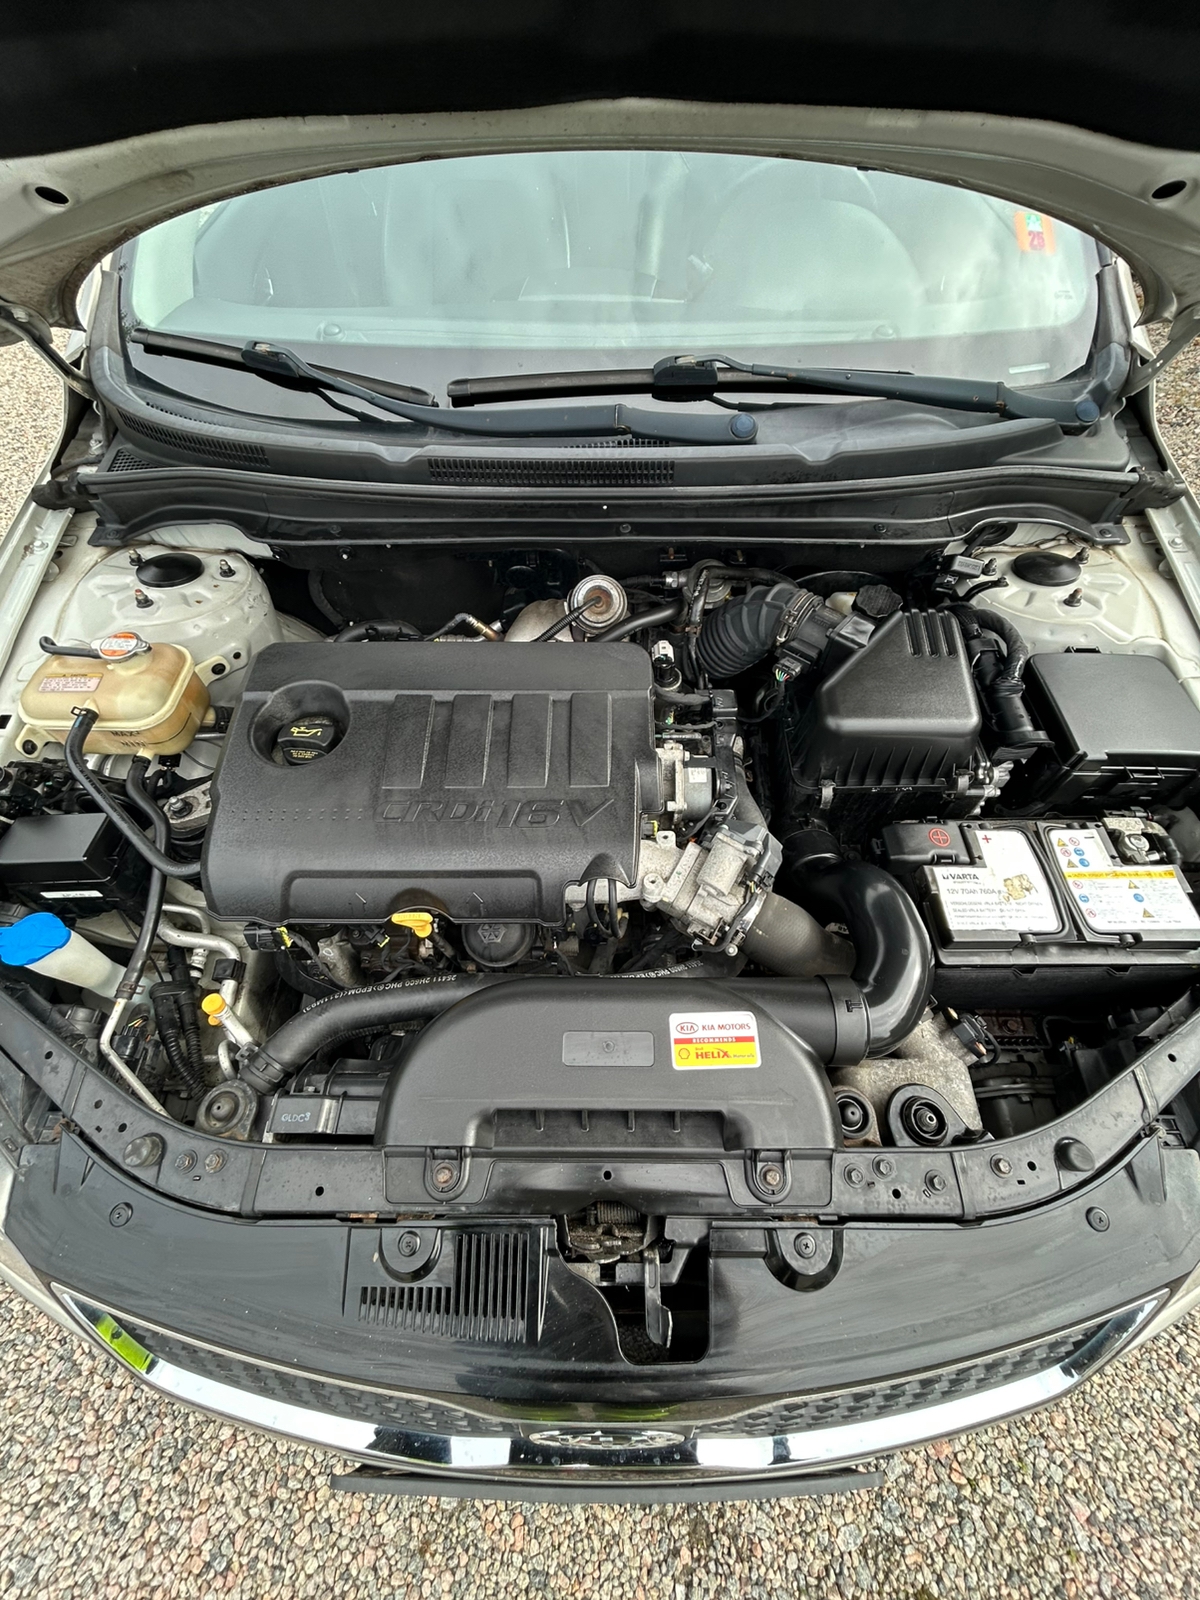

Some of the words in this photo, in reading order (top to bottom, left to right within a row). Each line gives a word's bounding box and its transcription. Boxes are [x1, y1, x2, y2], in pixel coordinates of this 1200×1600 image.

[496, 799, 614, 829] 16V
[432, 974, 458, 983] 25411
[718, 1023, 751, 1031] MOTORS
[695, 1049, 730, 1059] HELIX
